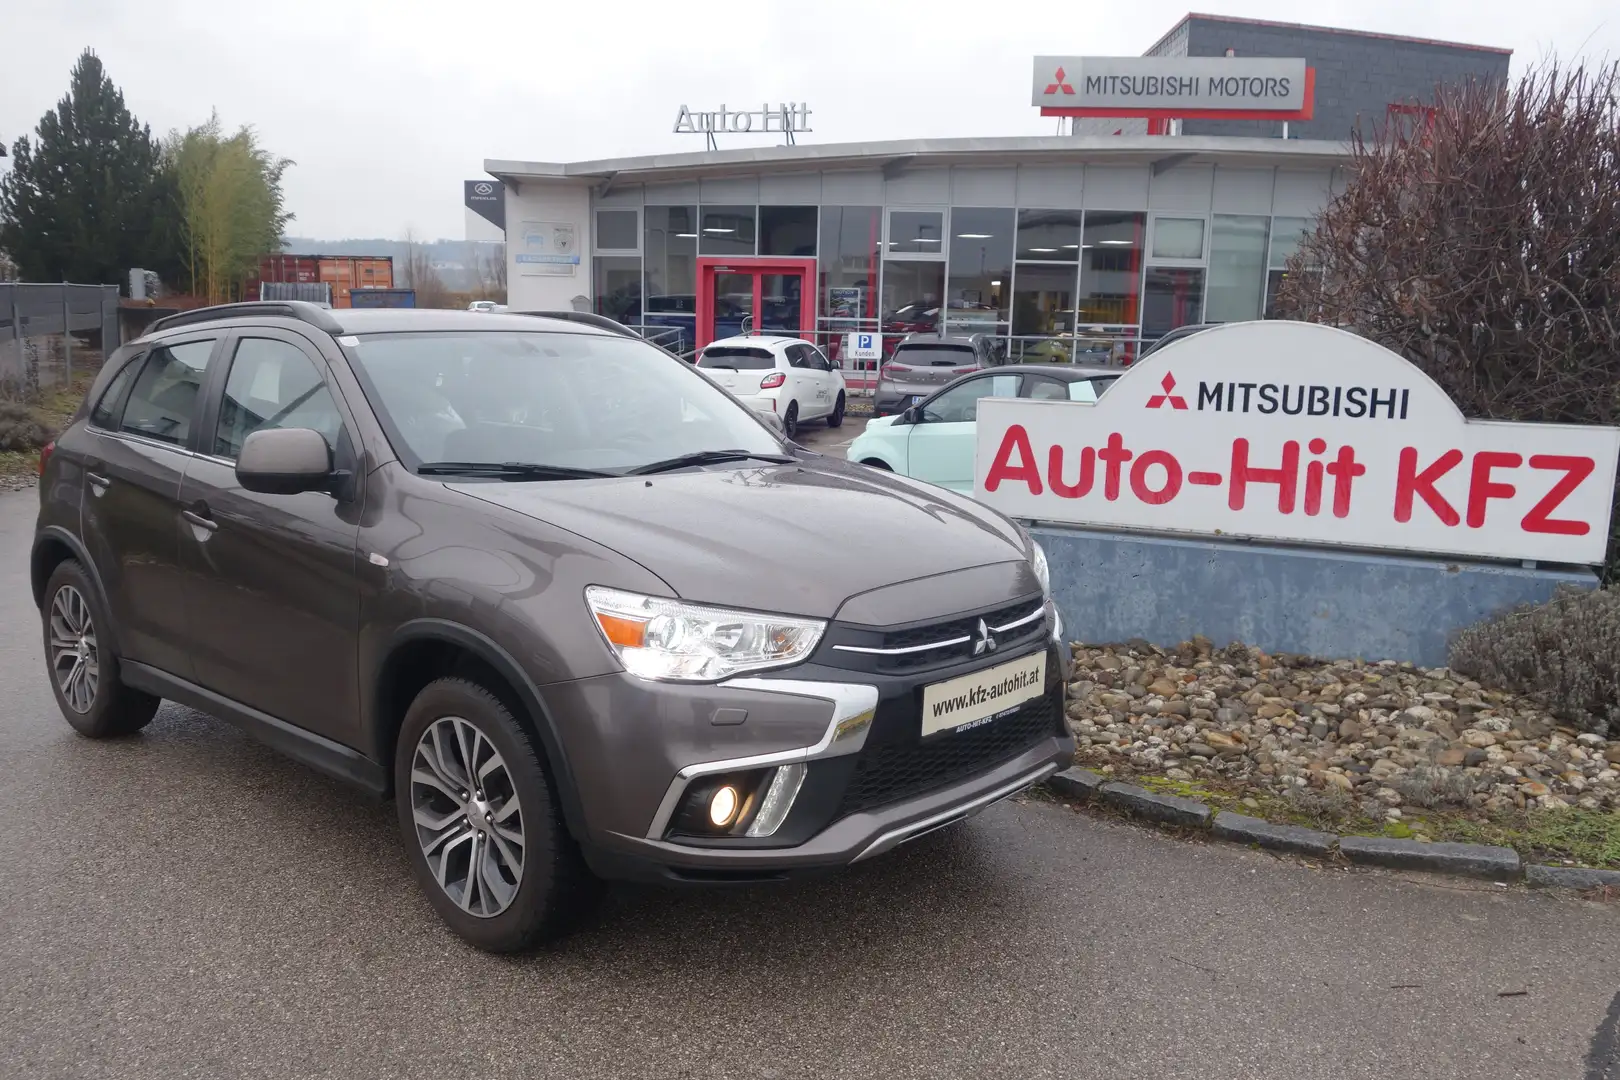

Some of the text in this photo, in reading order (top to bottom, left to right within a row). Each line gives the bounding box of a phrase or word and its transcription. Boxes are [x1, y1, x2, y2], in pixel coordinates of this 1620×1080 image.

[1086, 75, 1291, 98] MITSUBISHI MOTORS
[672, 101, 813, 133] Auto Hit
[1197, 380, 1411, 420] MITSUBISHI
[984, 423, 1596, 536] Auto-Hit KFZ
[932, 665, 1040, 718] www.kfz-autohit.at
